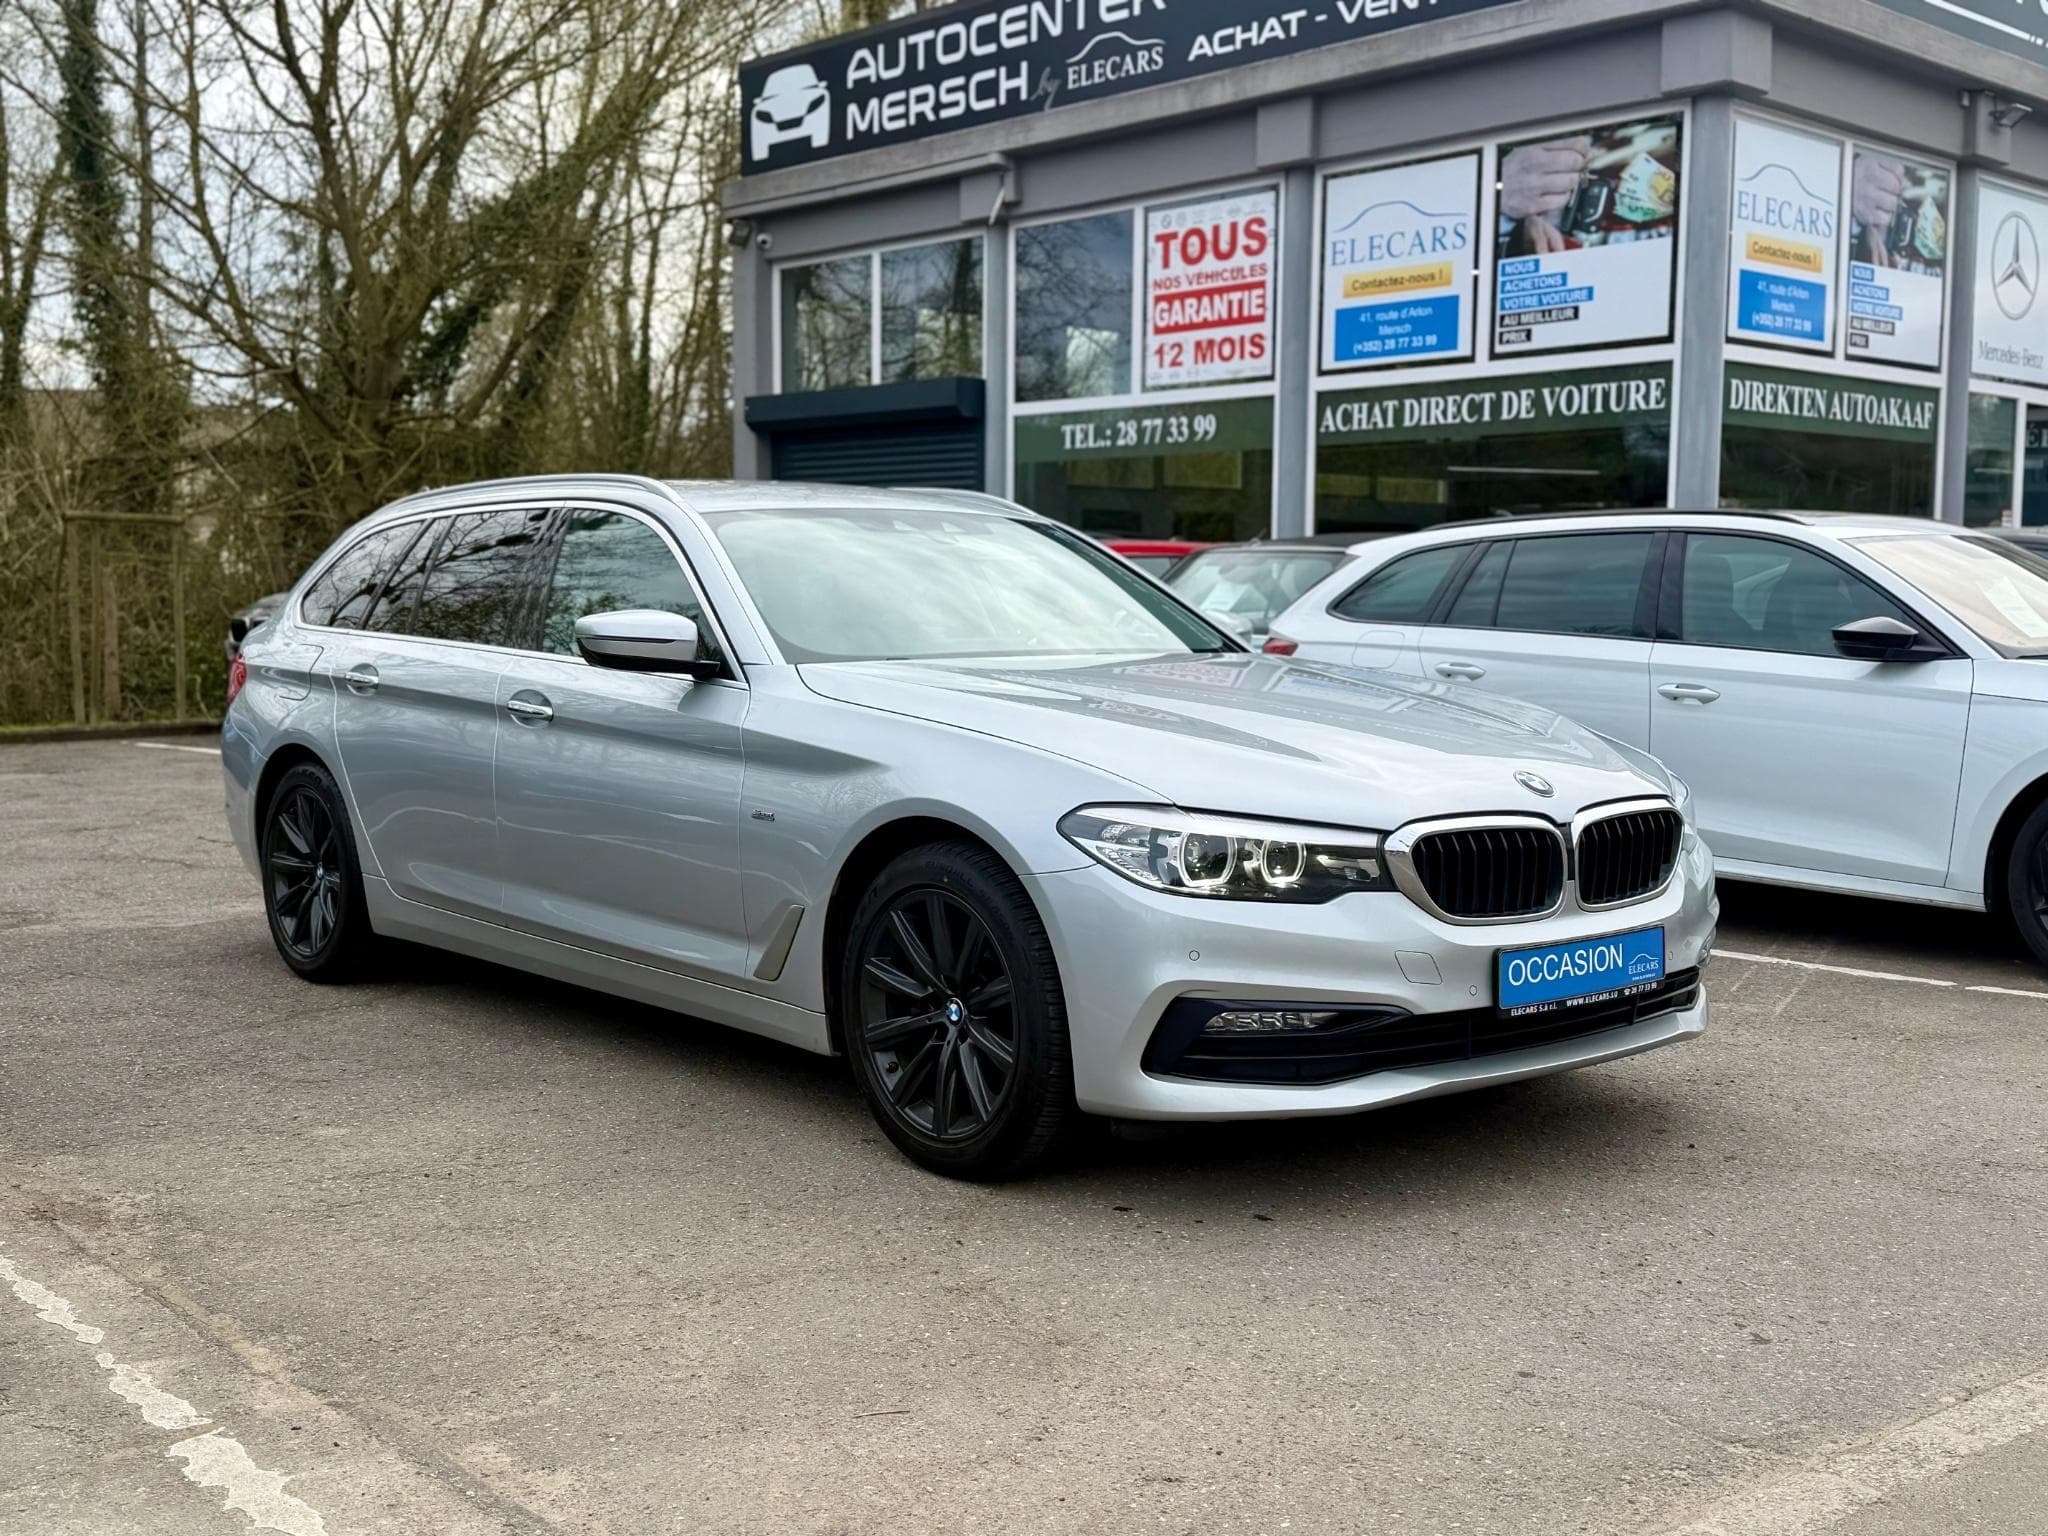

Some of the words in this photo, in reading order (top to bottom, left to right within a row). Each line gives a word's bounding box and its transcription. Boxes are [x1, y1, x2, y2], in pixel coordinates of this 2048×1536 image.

[1188, 10, 1307, 61] ACHAT
[1336, 0, 1438, 24] VEN
[1067, 46, 1164, 90] ELECARS
[846, 61, 1029, 140] MERSCH
[1737, 190, 1833, 239] ELECARS
[1155, 217, 1268, 269] TOUS
[1331, 222, 1468, 266] ELECARS
[1153, 277, 1181, 291] NOS
[1187, 263, 1268, 286] VEHICULES
[1504, 275, 1563, 292] ACHETONS
[1505, 261, 1536, 275] NOUS
[1155, 288, 1264, 327] GARANTIE
[1504, 293, 1540, 309] VOTRE
[1542, 289, 1590, 305] VOITURE
[1502, 313, 1520, 326] AU
[1521, 308, 1575, 324] MEILLEUR
[1154, 342, 1183, 368] 12
[1194, 333, 1265, 366] MOIS
[1502, 330, 1528, 343] PRIX
[1979, 340, 2044, 369] Mercedes-Benz
[1320, 400, 1398, 433] ACHAT
[1403, 392, 1496, 428] DIRECT
[1500, 388, 1535, 421] DE
[1542, 378, 1666, 417] VOITURE
[1729, 378, 1828, 419] DIREKTEN
[1829, 390, 1935, 430] AUTOAKAAF
[1116, 419, 1137, 446] 28
[1141, 418, 1162, 445] 77
[1166, 416, 1189, 443] 33
[1194, 414, 1216, 440] 99
[1508, 943, 1623, 986] OCCASION
[1628, 960, 1659, 975] ELECARS
[1511, 1005, 1538, 1017] ELECARS
